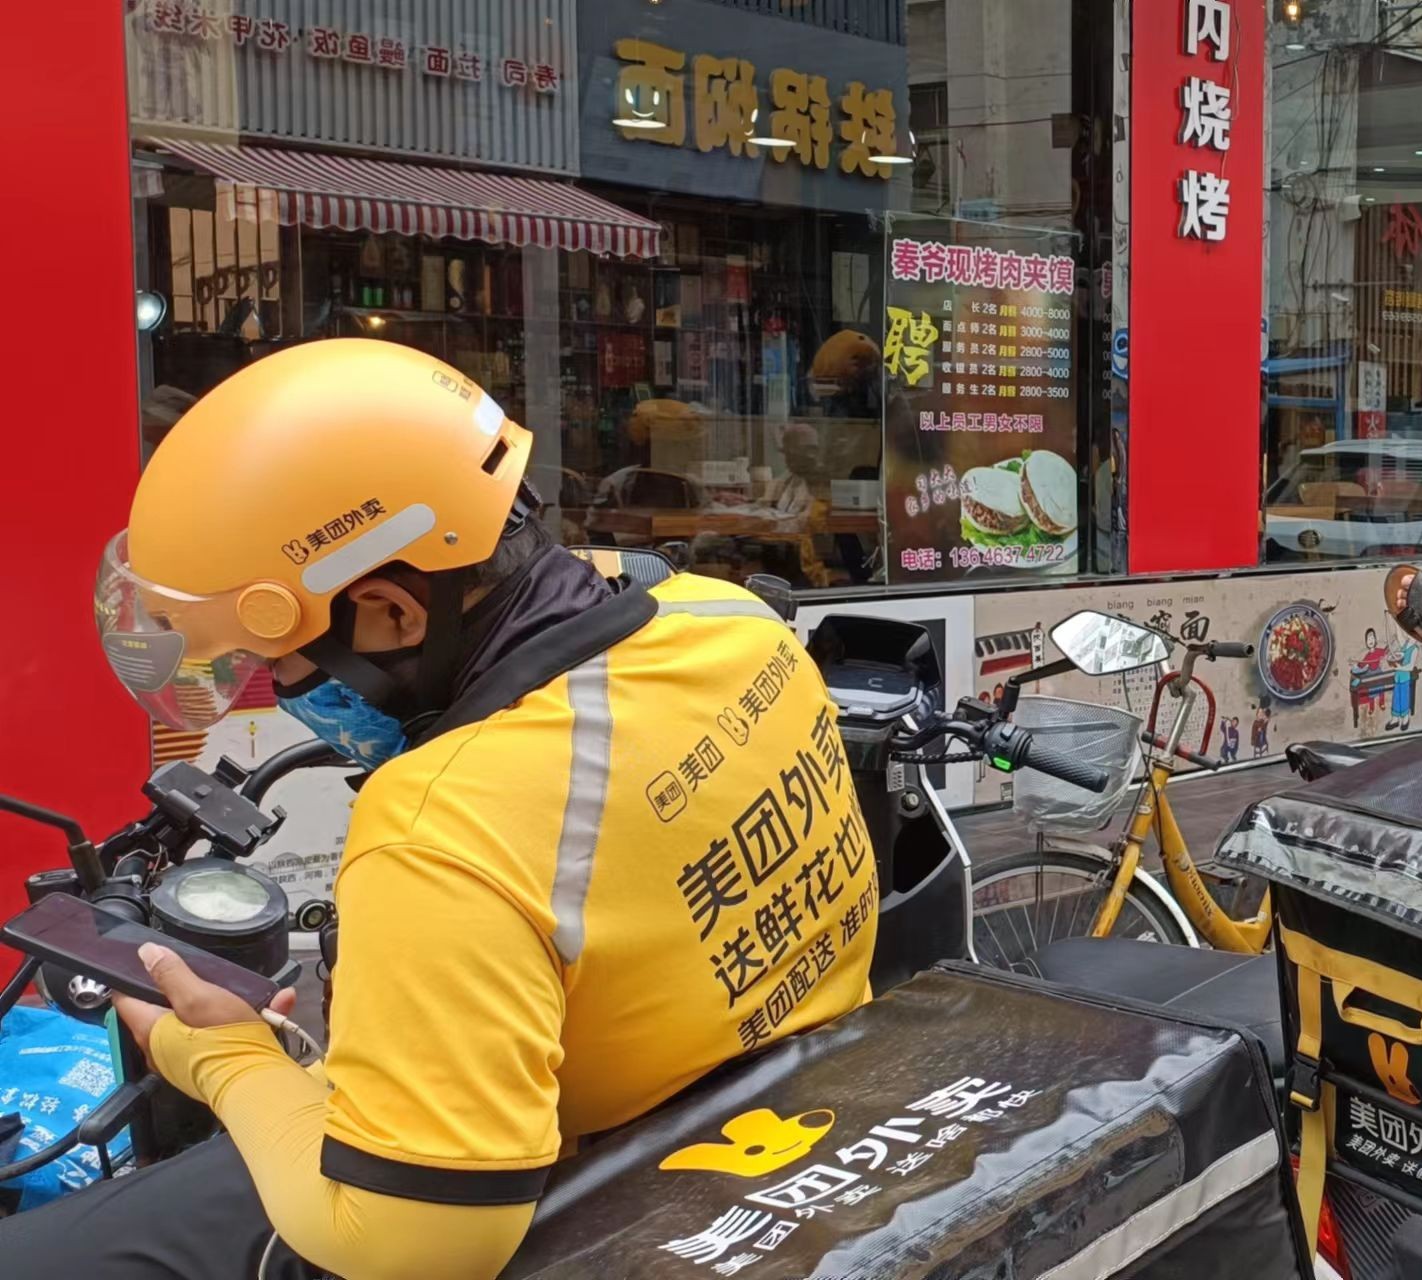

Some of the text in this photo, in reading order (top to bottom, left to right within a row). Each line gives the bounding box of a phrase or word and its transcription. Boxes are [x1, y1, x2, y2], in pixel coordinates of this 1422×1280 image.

[1181, 0, 1231, 241] 内烧烤
[892, 239, 1074, 294] 秦爷现烤肉夹馍
[884, 306, 939, 387] 聘
[919, 412, 1044, 433] 以上员工男女不限
[306, 498, 387, 551] 美团外卖
[901, 548, 942, 571] 电话:
[949, 546, 980, 568] 136
[739, 639, 800, 724] 美团外卖
[654, 781, 682, 811] 美团
[679, 735, 725, 792] 美团
[676, 705, 846, 942] 美团外卖
[711, 784, 869, 1009] 送鲜花也
[737, 872, 877, 1049] 美团配送 准时
[658, 1076, 1012, 1263] 美团外卖
[1346, 1133, 1400, 1168] 美团外卖
[711, 1184, 881, 1275] 美团外卖
